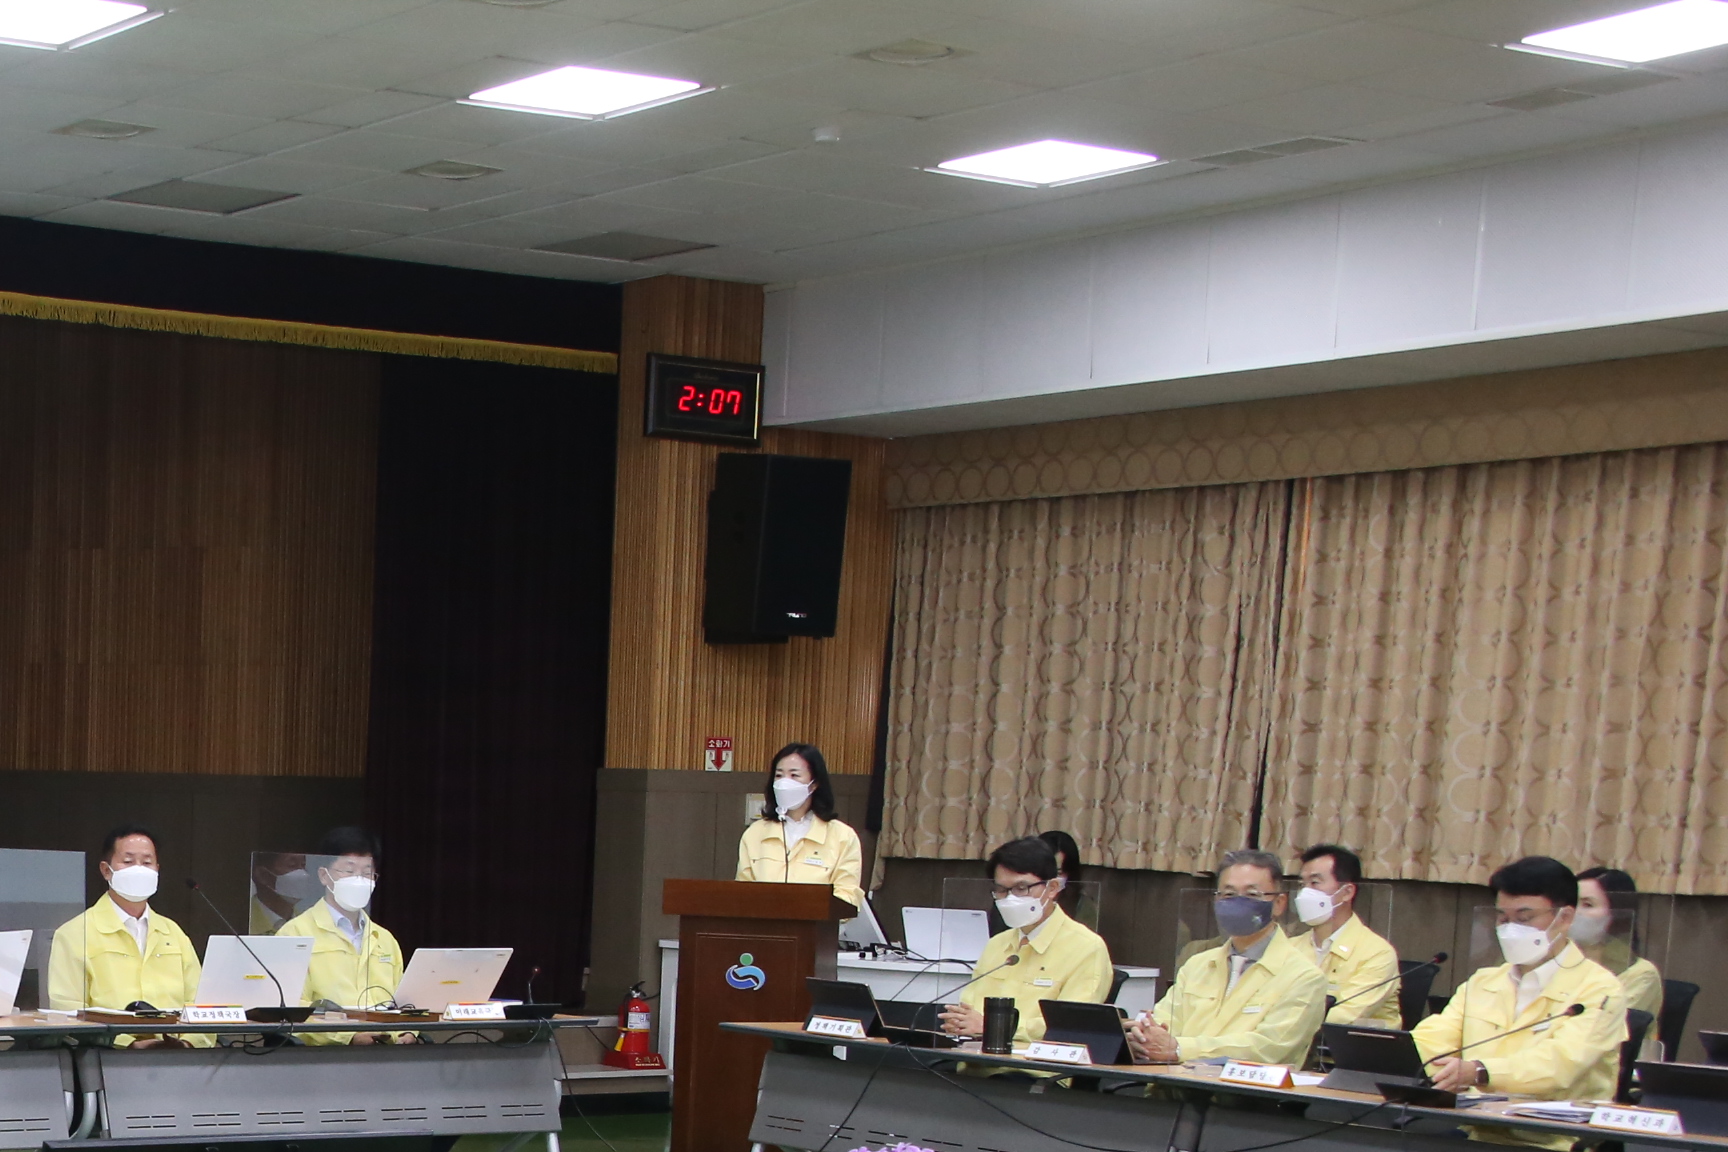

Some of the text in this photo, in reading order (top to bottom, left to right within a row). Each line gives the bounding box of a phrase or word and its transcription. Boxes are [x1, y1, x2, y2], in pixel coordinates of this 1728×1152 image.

[678, 385, 742, 415] 2:07
[708, 739, 731, 748] 소화기
[1033, 1046, 1077, 1059] 감사관
[1227, 1067, 1275, 1081] 홍보담당
